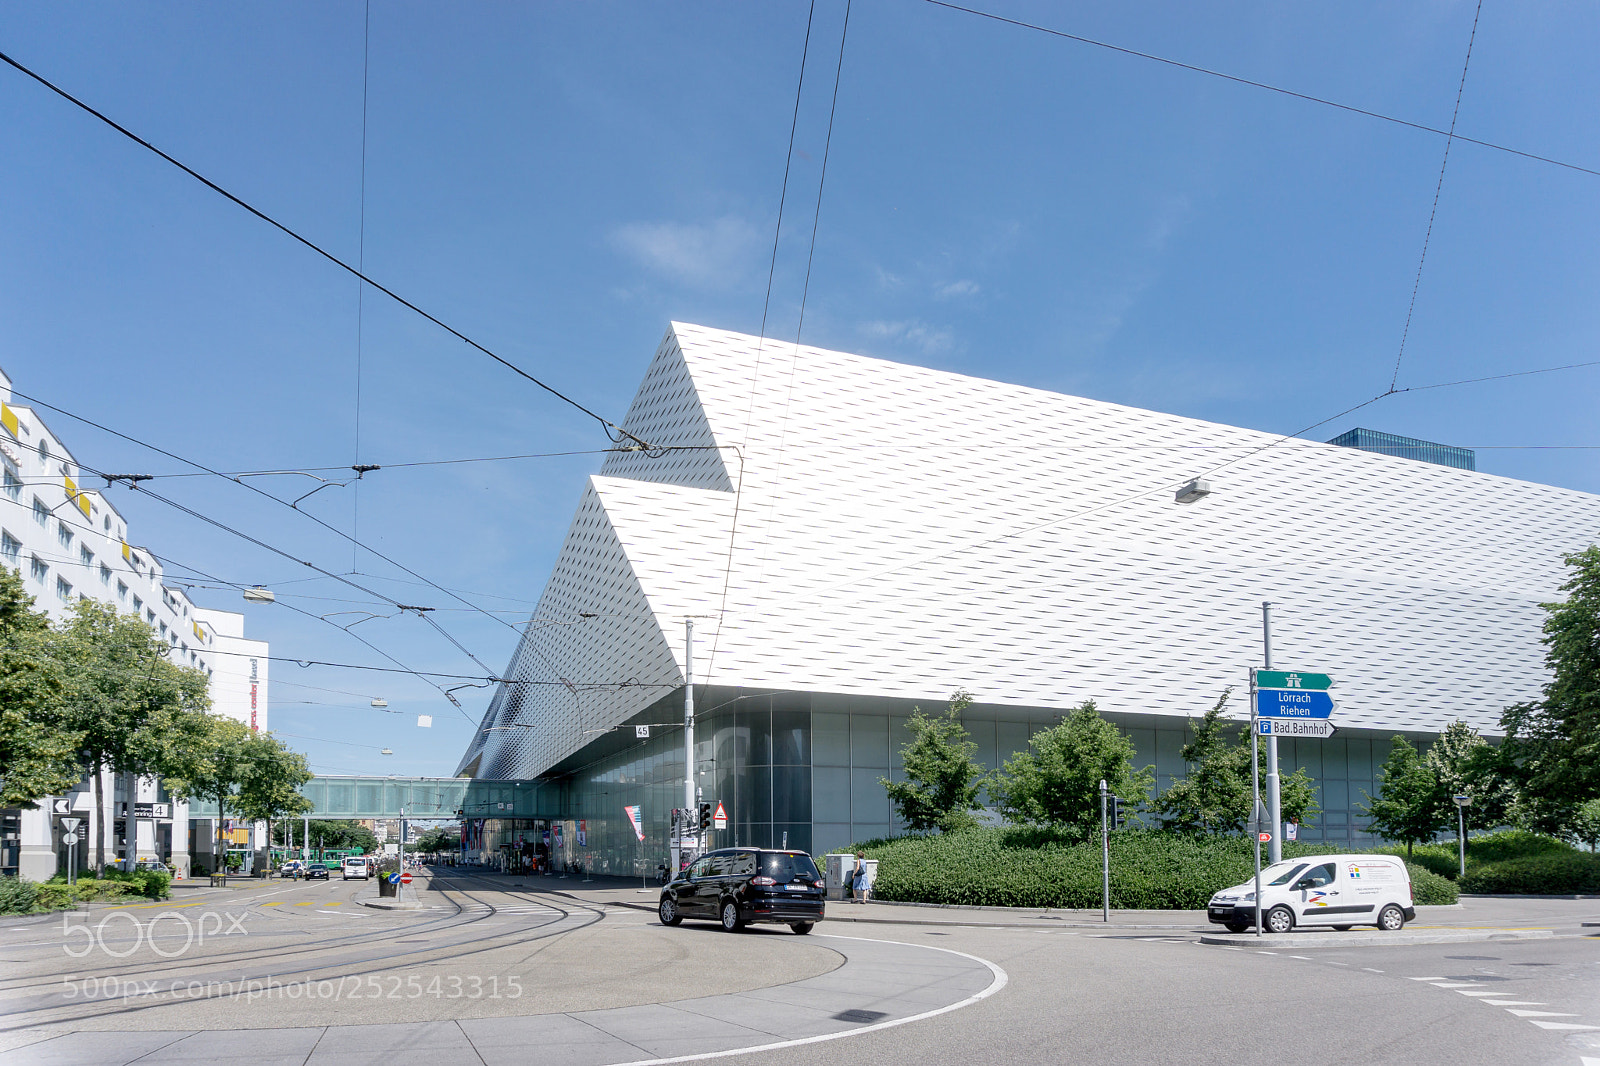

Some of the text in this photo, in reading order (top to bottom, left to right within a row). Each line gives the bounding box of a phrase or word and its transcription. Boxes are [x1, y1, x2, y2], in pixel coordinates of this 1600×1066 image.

[249, 684, 258, 709] center
[1278, 692, 1311, 703] Lörrach
[1280, 705, 1311, 716] Riehen
[638, 727, 648, 735] 45
[1274, 722, 1328, 735] Bad.Bahnhof
[154, 805, 163, 816] 4
